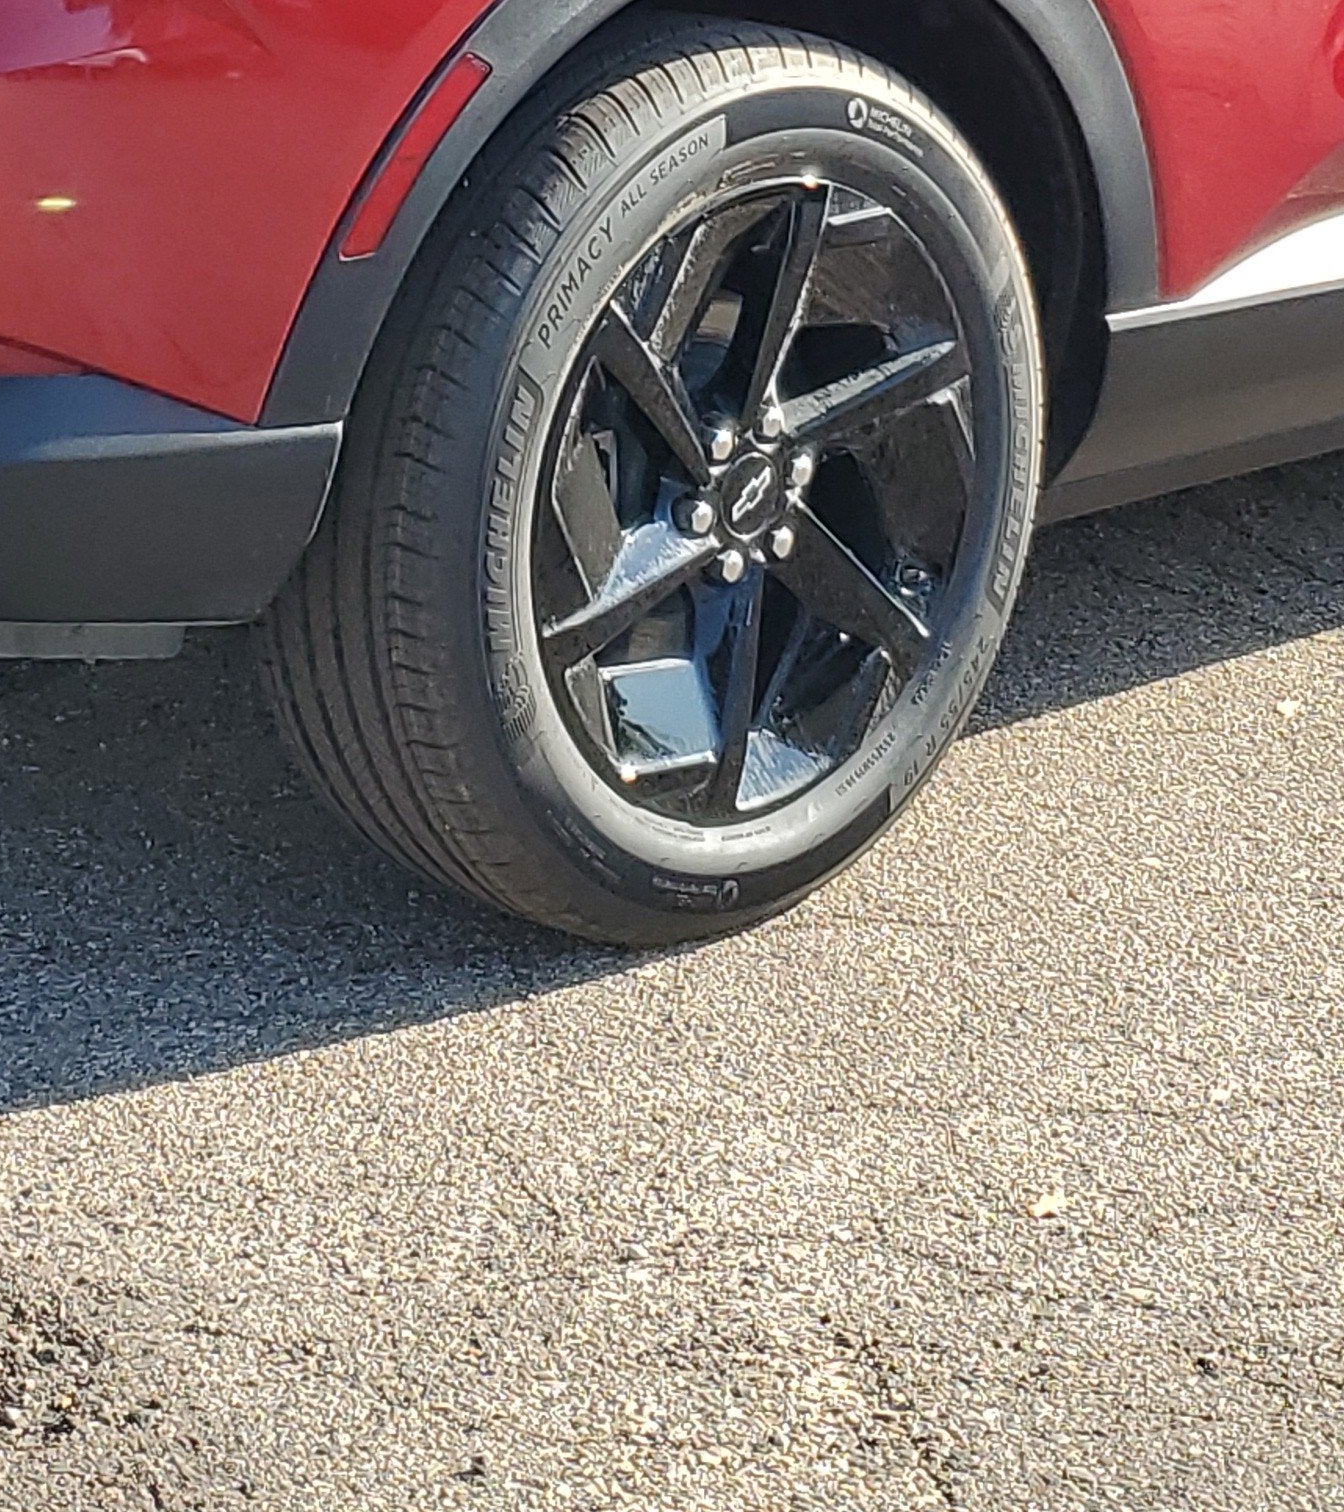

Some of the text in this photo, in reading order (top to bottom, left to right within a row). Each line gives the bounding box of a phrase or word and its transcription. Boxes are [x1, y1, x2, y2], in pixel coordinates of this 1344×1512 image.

[537, 133, 709, 350] PRIMACY ALL SEASON
[484, 384, 536, 652] MICHELIN
[993, 362, 1031, 601] MICHELIN
